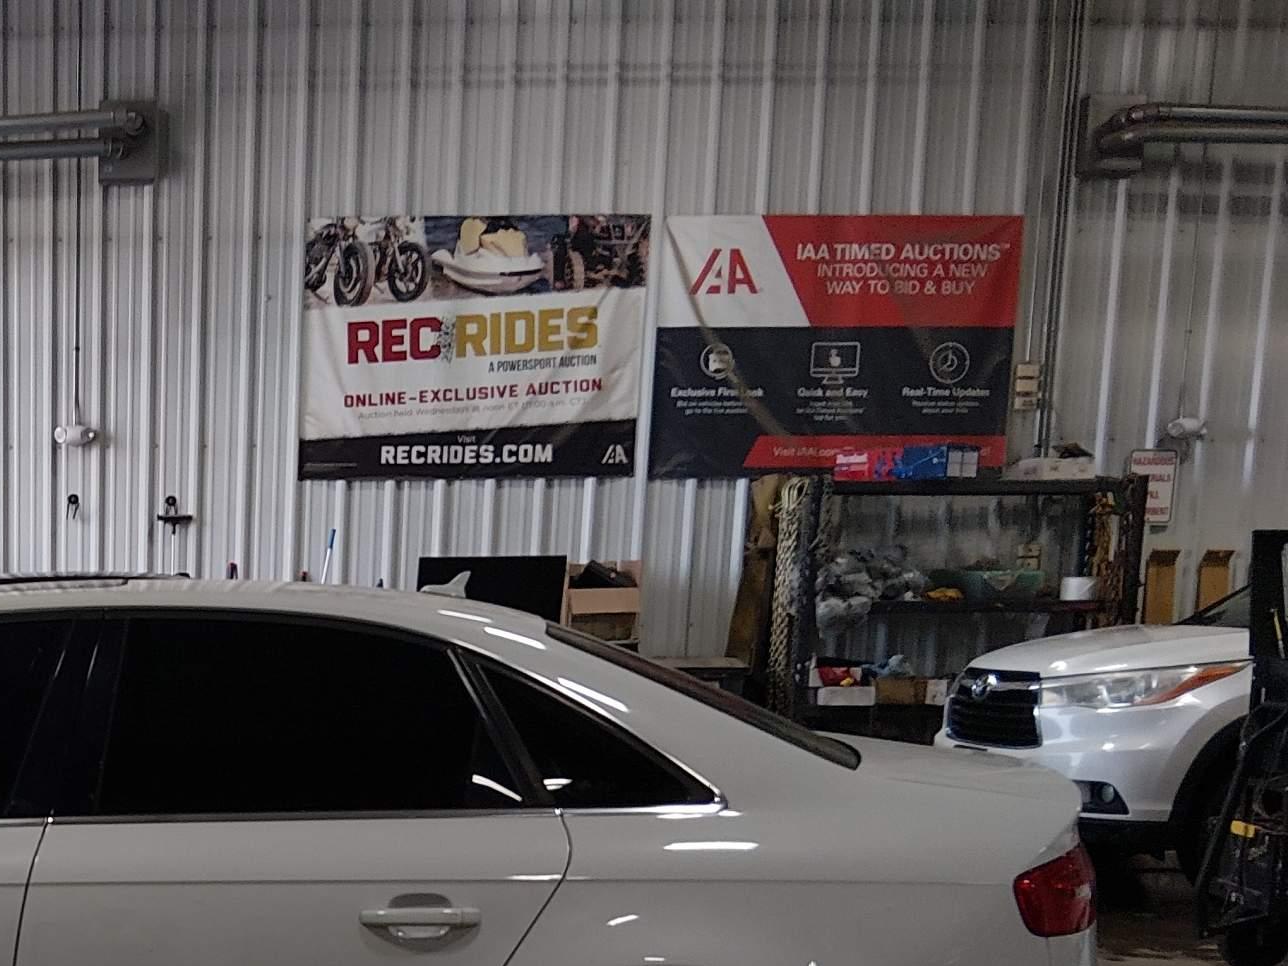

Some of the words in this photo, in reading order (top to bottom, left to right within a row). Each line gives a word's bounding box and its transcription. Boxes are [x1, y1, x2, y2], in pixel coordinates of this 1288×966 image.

[796, 243, 830, 260] IAA
[833, 243, 895, 260] TIMED
[816, 263, 928, 278] INTRODUCING
[933, 263, 944, 277] A
[949, 263, 989, 277] NEW
[826, 280, 863, 295] WAY
[868, 280, 889, 295] TO
[895, 280, 918, 295] BID
[923, 280, 937, 295] &
[944, 280, 976, 295] BUY
[347, 316, 444, 364] REC
[455, 306, 599, 358] RIDES
[488, 361, 495, 373] A
[497, 357, 557, 373] POWERSPORT
[560, 354, 598, 369] AUCTION
[343, 384, 519, 409] ONLINE-EXCLUSIVE
[525, 377, 603, 399] AUCTION
[797, 387, 823, 398] Quick
[825, 388, 844, 398] and
[845, 387, 869, 400] Easy
[901, 387, 951, 398] Real-Time
[457, 434, 476, 444] Visit
[380, 443, 553, 465] RECRIDES.COM
